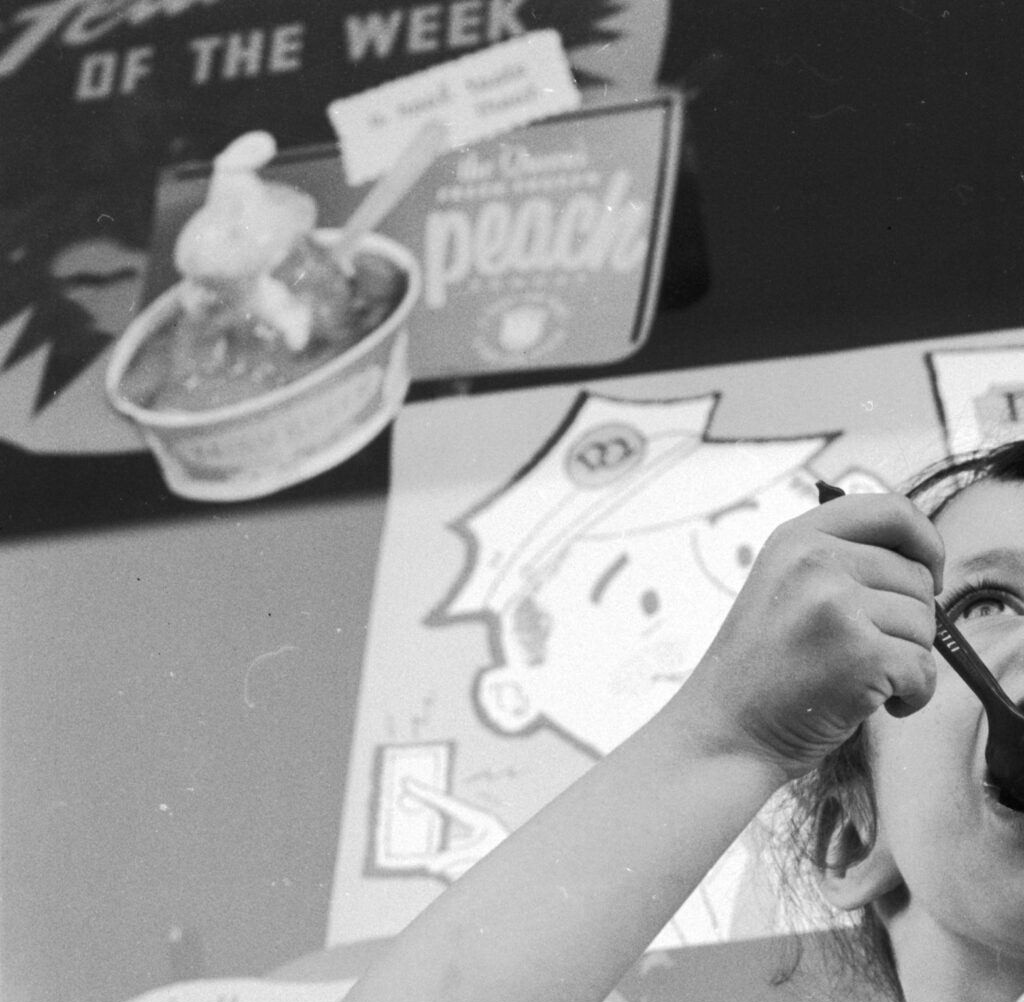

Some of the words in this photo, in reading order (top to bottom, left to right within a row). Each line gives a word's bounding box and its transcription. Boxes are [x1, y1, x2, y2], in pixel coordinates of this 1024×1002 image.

[75, 45, 155, 101] OF
[189, 23, 306, 86] THE
[345, 0, 526, 60] WEEK
[424, 170, 650, 309] peach
